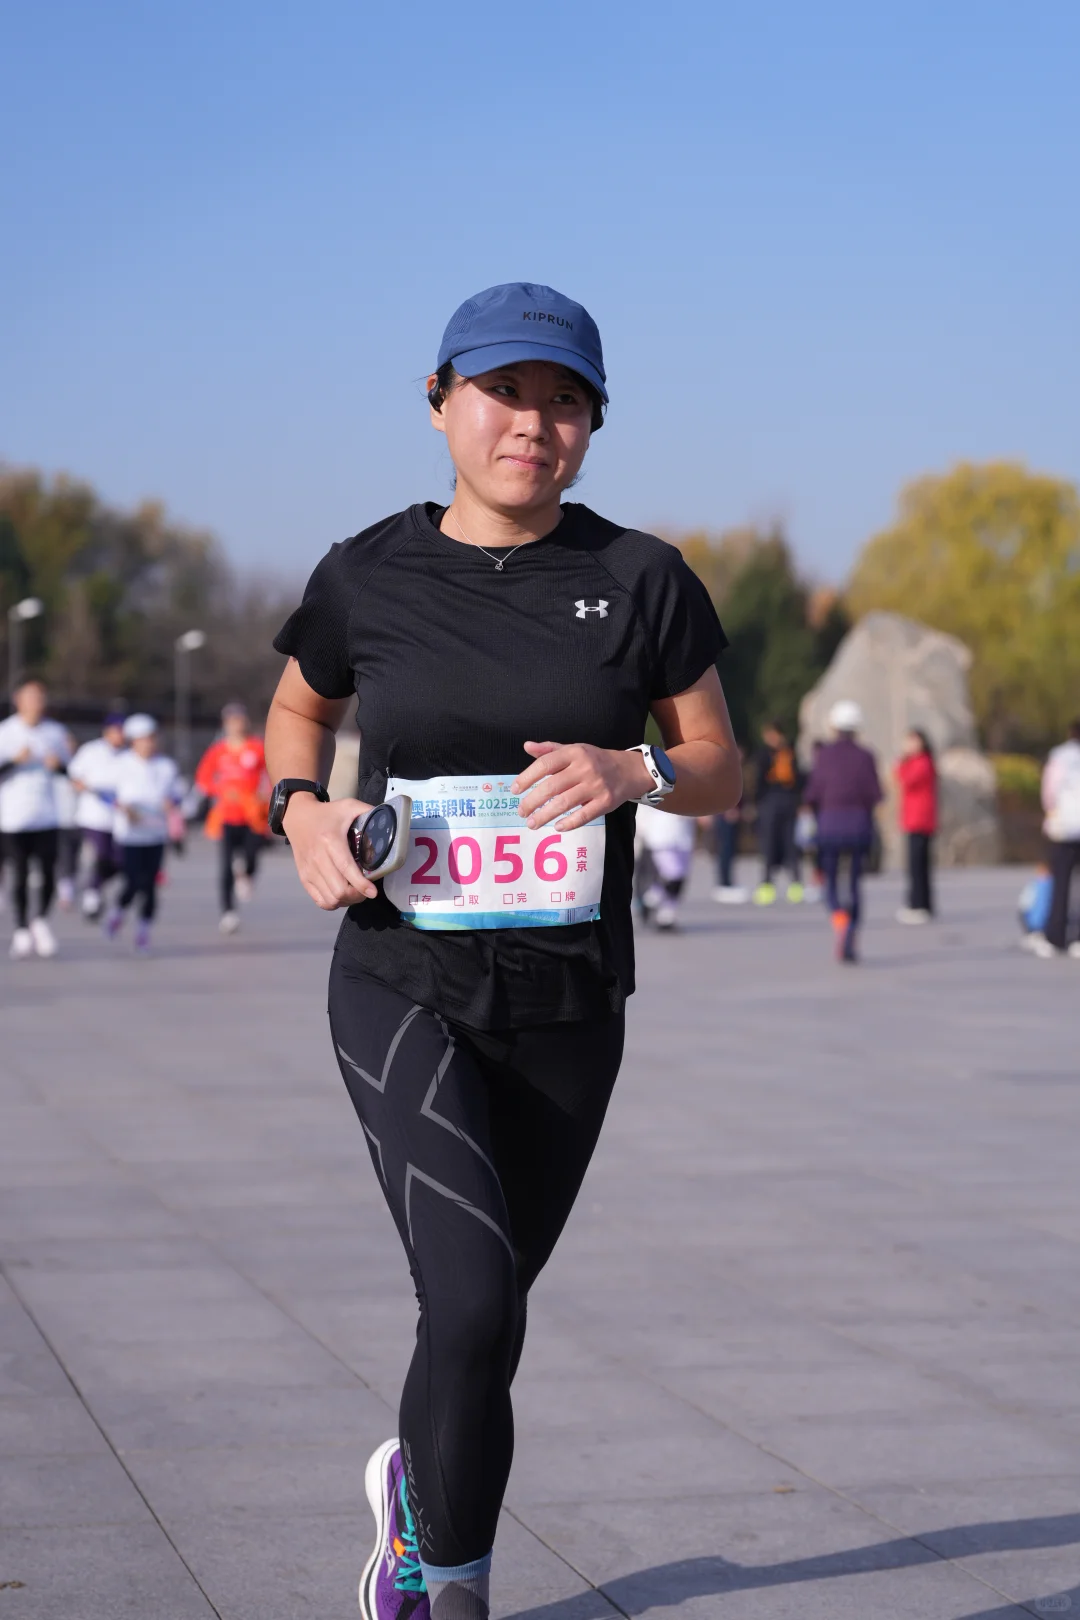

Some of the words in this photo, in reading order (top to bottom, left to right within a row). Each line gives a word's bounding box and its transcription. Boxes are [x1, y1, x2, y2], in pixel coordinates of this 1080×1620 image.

[523, 311, 573, 331] KIPRUN
[411, 799, 476, 818] 奥森锻炼
[478, 797, 520, 810] 2025奥
[410, 834, 568, 885] 2056
[576, 846, 588, 873] 贡京
[421, 894, 432, 905] 存
[468, 894, 479, 905] 取
[517, 892, 528, 903] 完
[565, 891, 576, 902] 牌
